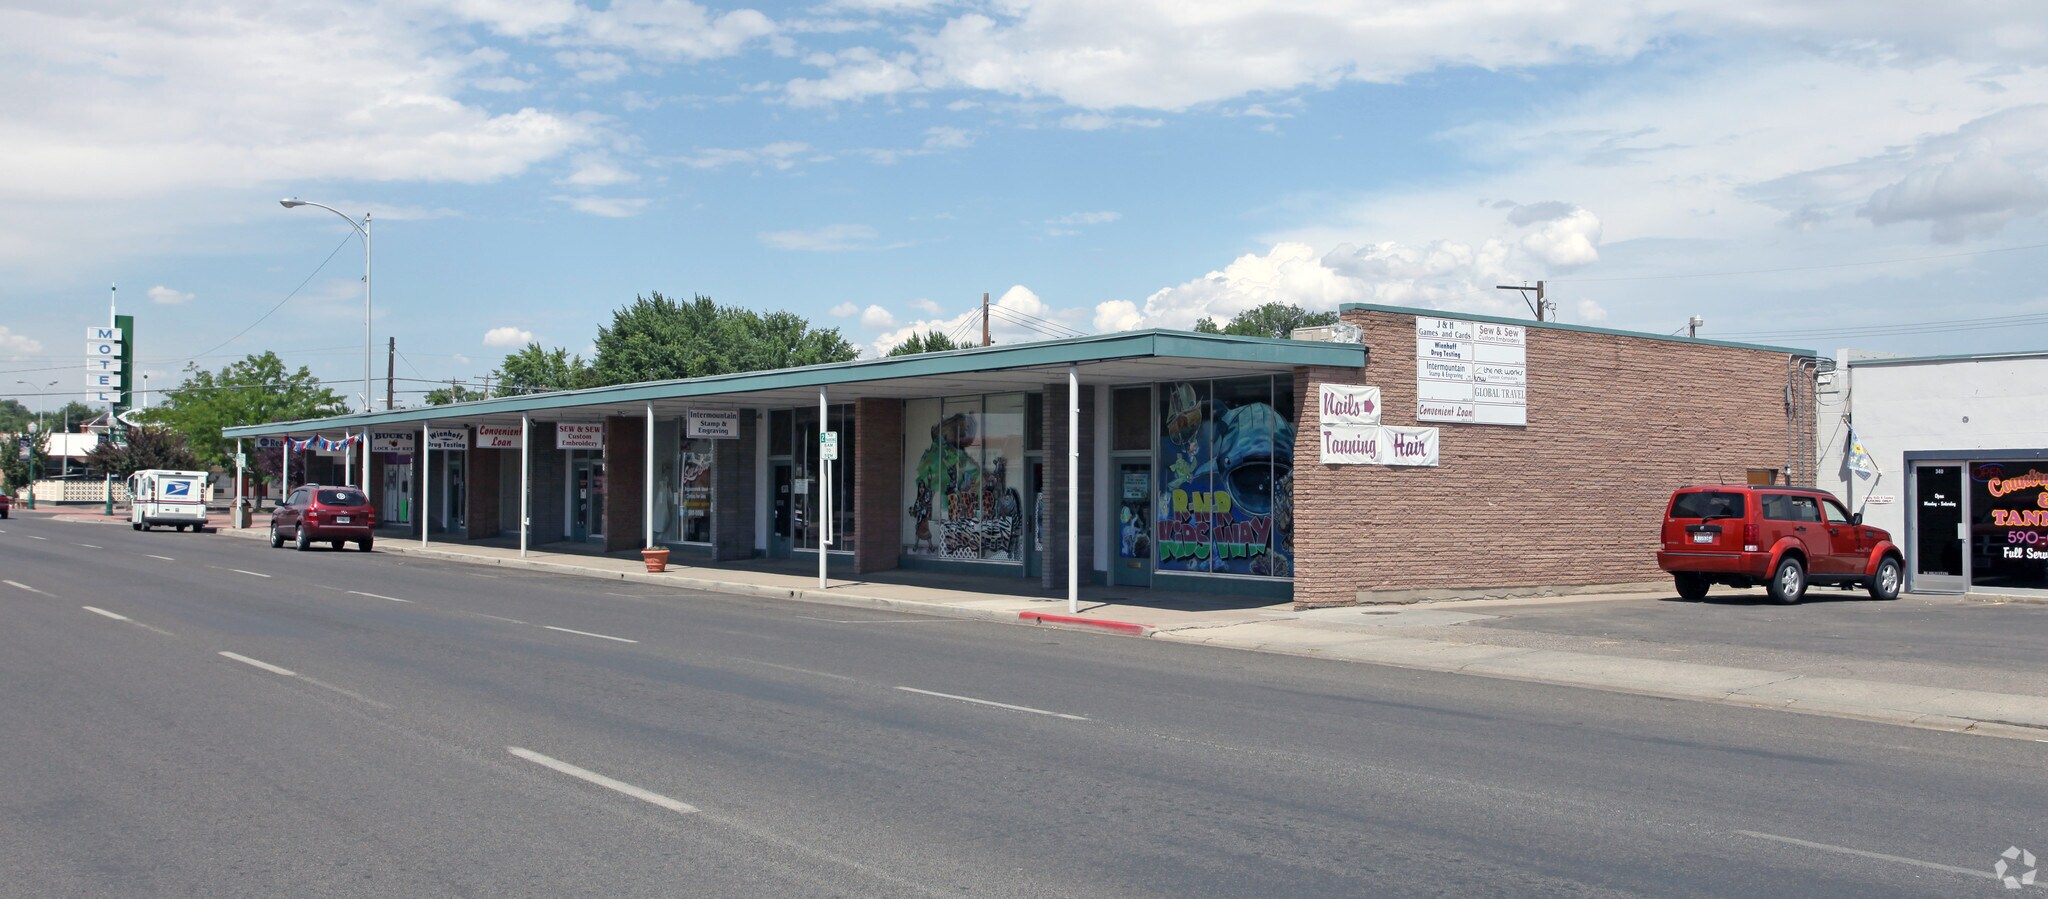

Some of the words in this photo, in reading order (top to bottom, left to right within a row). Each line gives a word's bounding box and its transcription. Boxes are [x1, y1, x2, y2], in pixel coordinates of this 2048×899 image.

[1419, 328, 1438, 336] Games
[1479, 325, 1494, 335] Sew
[1496, 327, 1501, 335] &
[1504, 328, 1519, 337] Sew
[1496, 336, 1520, 344] Embroidery
[98, 328, 112, 400] MOTEL
[1426, 361, 1465, 372] Intermountain
[1474, 387, 1500, 398] GLOBAL
[1501, 389, 1525, 399] TRAVEL
[1324, 392, 1360, 417] Nails
[1420, 404, 1454, 417] Convenient
[1457, 406, 1473, 417] Loan
[430, 430, 464, 440] Wienhoff
[480, 425, 522, 436] Convenient
[491, 437, 512, 446] Loan
[1324, 431, 1376, 460] Tanning
[1394, 433, 1427, 457] Hair
[2008, 531, 2048, 544] 590-
[2003, 547, 2023, 558] Full
[2026, 547, 2048, 560] Serv
